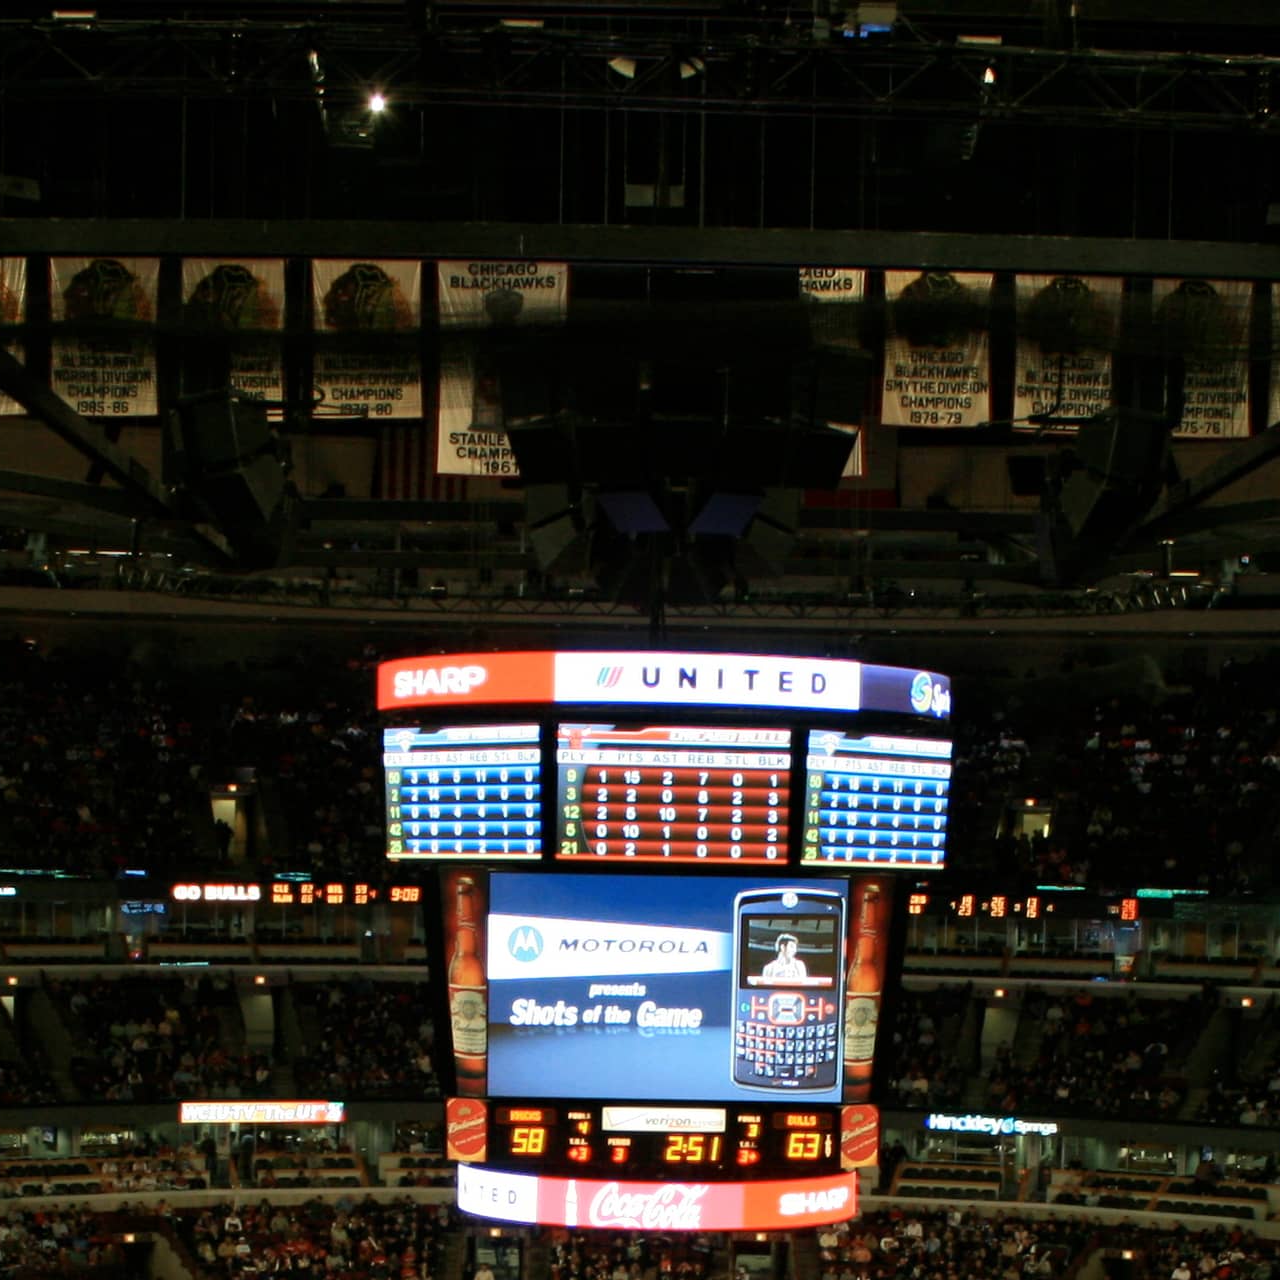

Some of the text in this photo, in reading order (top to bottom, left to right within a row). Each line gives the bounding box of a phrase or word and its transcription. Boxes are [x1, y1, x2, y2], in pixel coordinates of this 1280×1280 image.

[468, 263, 538, 276] CHICAGO
[450, 276, 555, 290] BLACKHAWKS
[937, 381, 989, 394] DIVISION
[901, 396, 972, 409] CHAMPIONS
[449, 433, 506, 446] STANLE
[394, 666, 487, 698] SHARP
[642, 666, 827, 694] UNITED
[561, 752, 585, 761] PLY
[652, 754, 678, 763] AST
[687, 754, 716, 764] REB
[724, 755, 749, 765] STL
[758, 755, 786, 766] BLK
[599, 770, 607, 784] 1
[623, 770, 641, 785] 15
[663, 771, 673, 786] 2
[699, 772, 709, 786] 7
[769, 774, 777, 788] 1
[597, 788, 608, 802] 2
[627, 788, 637, 803] 2
[732, 791, 743, 805] 2
[563, 805, 579, 820] 12
[597, 806, 608, 821] 2
[659, 807, 676, 822] 10
[698, 808, 708, 822] 7
[732, 809, 742, 823] 2
[596, 824, 607, 838] 0
[664, 825, 672, 840] 1
[697, 826, 708, 840] 0
[731, 827, 742, 841] 0
[767, 828, 777, 842] 2
[596, 841, 607, 856] 0
[626, 842, 637, 856] 2
[663, 843, 671, 857] 1
[697, 844, 708, 858] 0
[731, 845, 742, 859] 0
[766, 845, 777, 860] 0
[173, 885, 261, 900] GO BULLS
[390, 887, 420, 902] 9:08
[558, 938, 709, 954] MOTOROLA
[509, 998, 704, 1029] Shots of the Game
[644, 1114, 692, 1129] verizon
[928, 1113, 1058, 1136] Hinckley Springs
[511, 1127, 545, 1154] 58
[665, 1135, 720, 1162] 2:51
[787, 1132, 821, 1159] 63
[589, 1182, 711, 1230] Coca-Cola
[778, 1185, 850, 1216] SHARP
